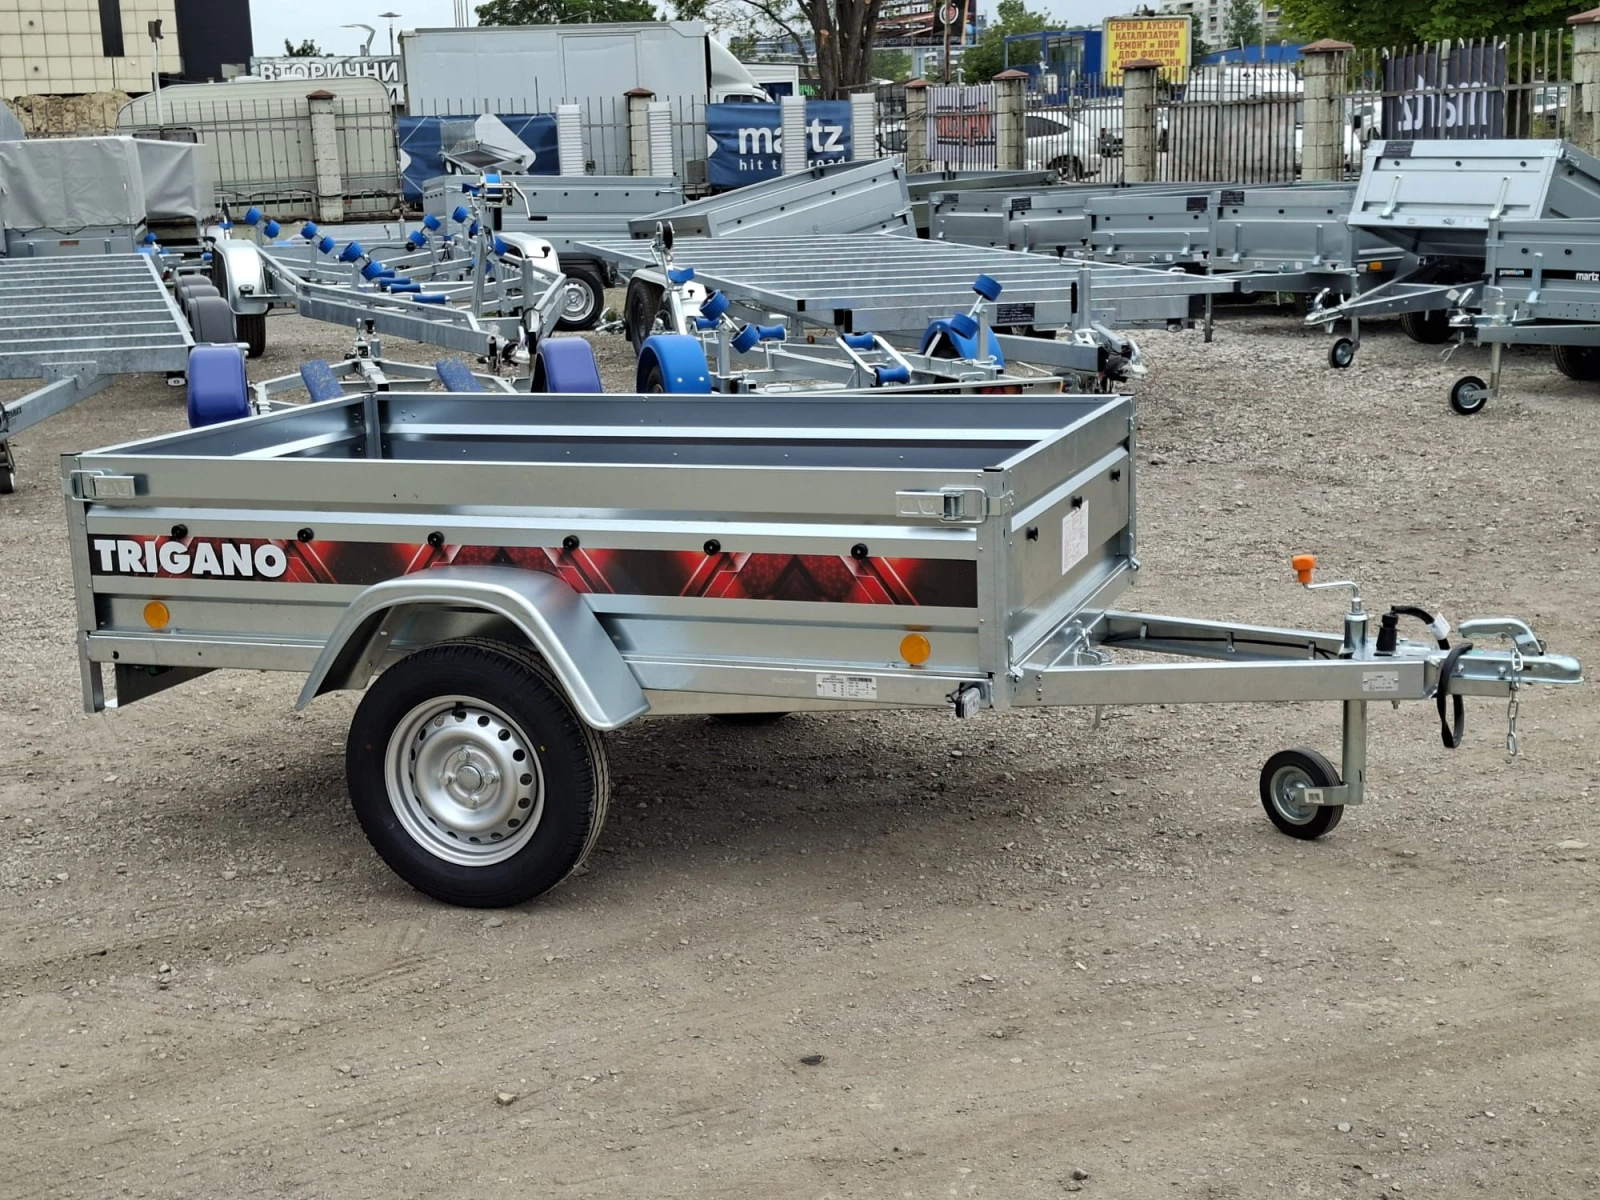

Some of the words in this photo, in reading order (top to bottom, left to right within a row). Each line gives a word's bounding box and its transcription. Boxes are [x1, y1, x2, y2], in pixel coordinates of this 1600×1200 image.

[1110, 22, 1143, 31] СЕРВИЗ
[1146, 20, 1185, 30] АУСПУСИ
[1115, 31, 1179, 41] КАТАЛИЗАТОРИ
[1114, 40, 1147, 50] РЕМОНТ
[1157, 40, 1180, 49] НОВИ
[1118, 50, 1138, 60] ДПФ
[1140, 49, 1176, 58] ФИЛТРИ
[259, 62, 399, 82] ВТОРИЧНИ
[738, 117, 845, 155] mtz
[739, 159, 764, 171] hit
[1575, 272, 1600, 282] martz
[93, 539, 288, 578] TRIGANO
